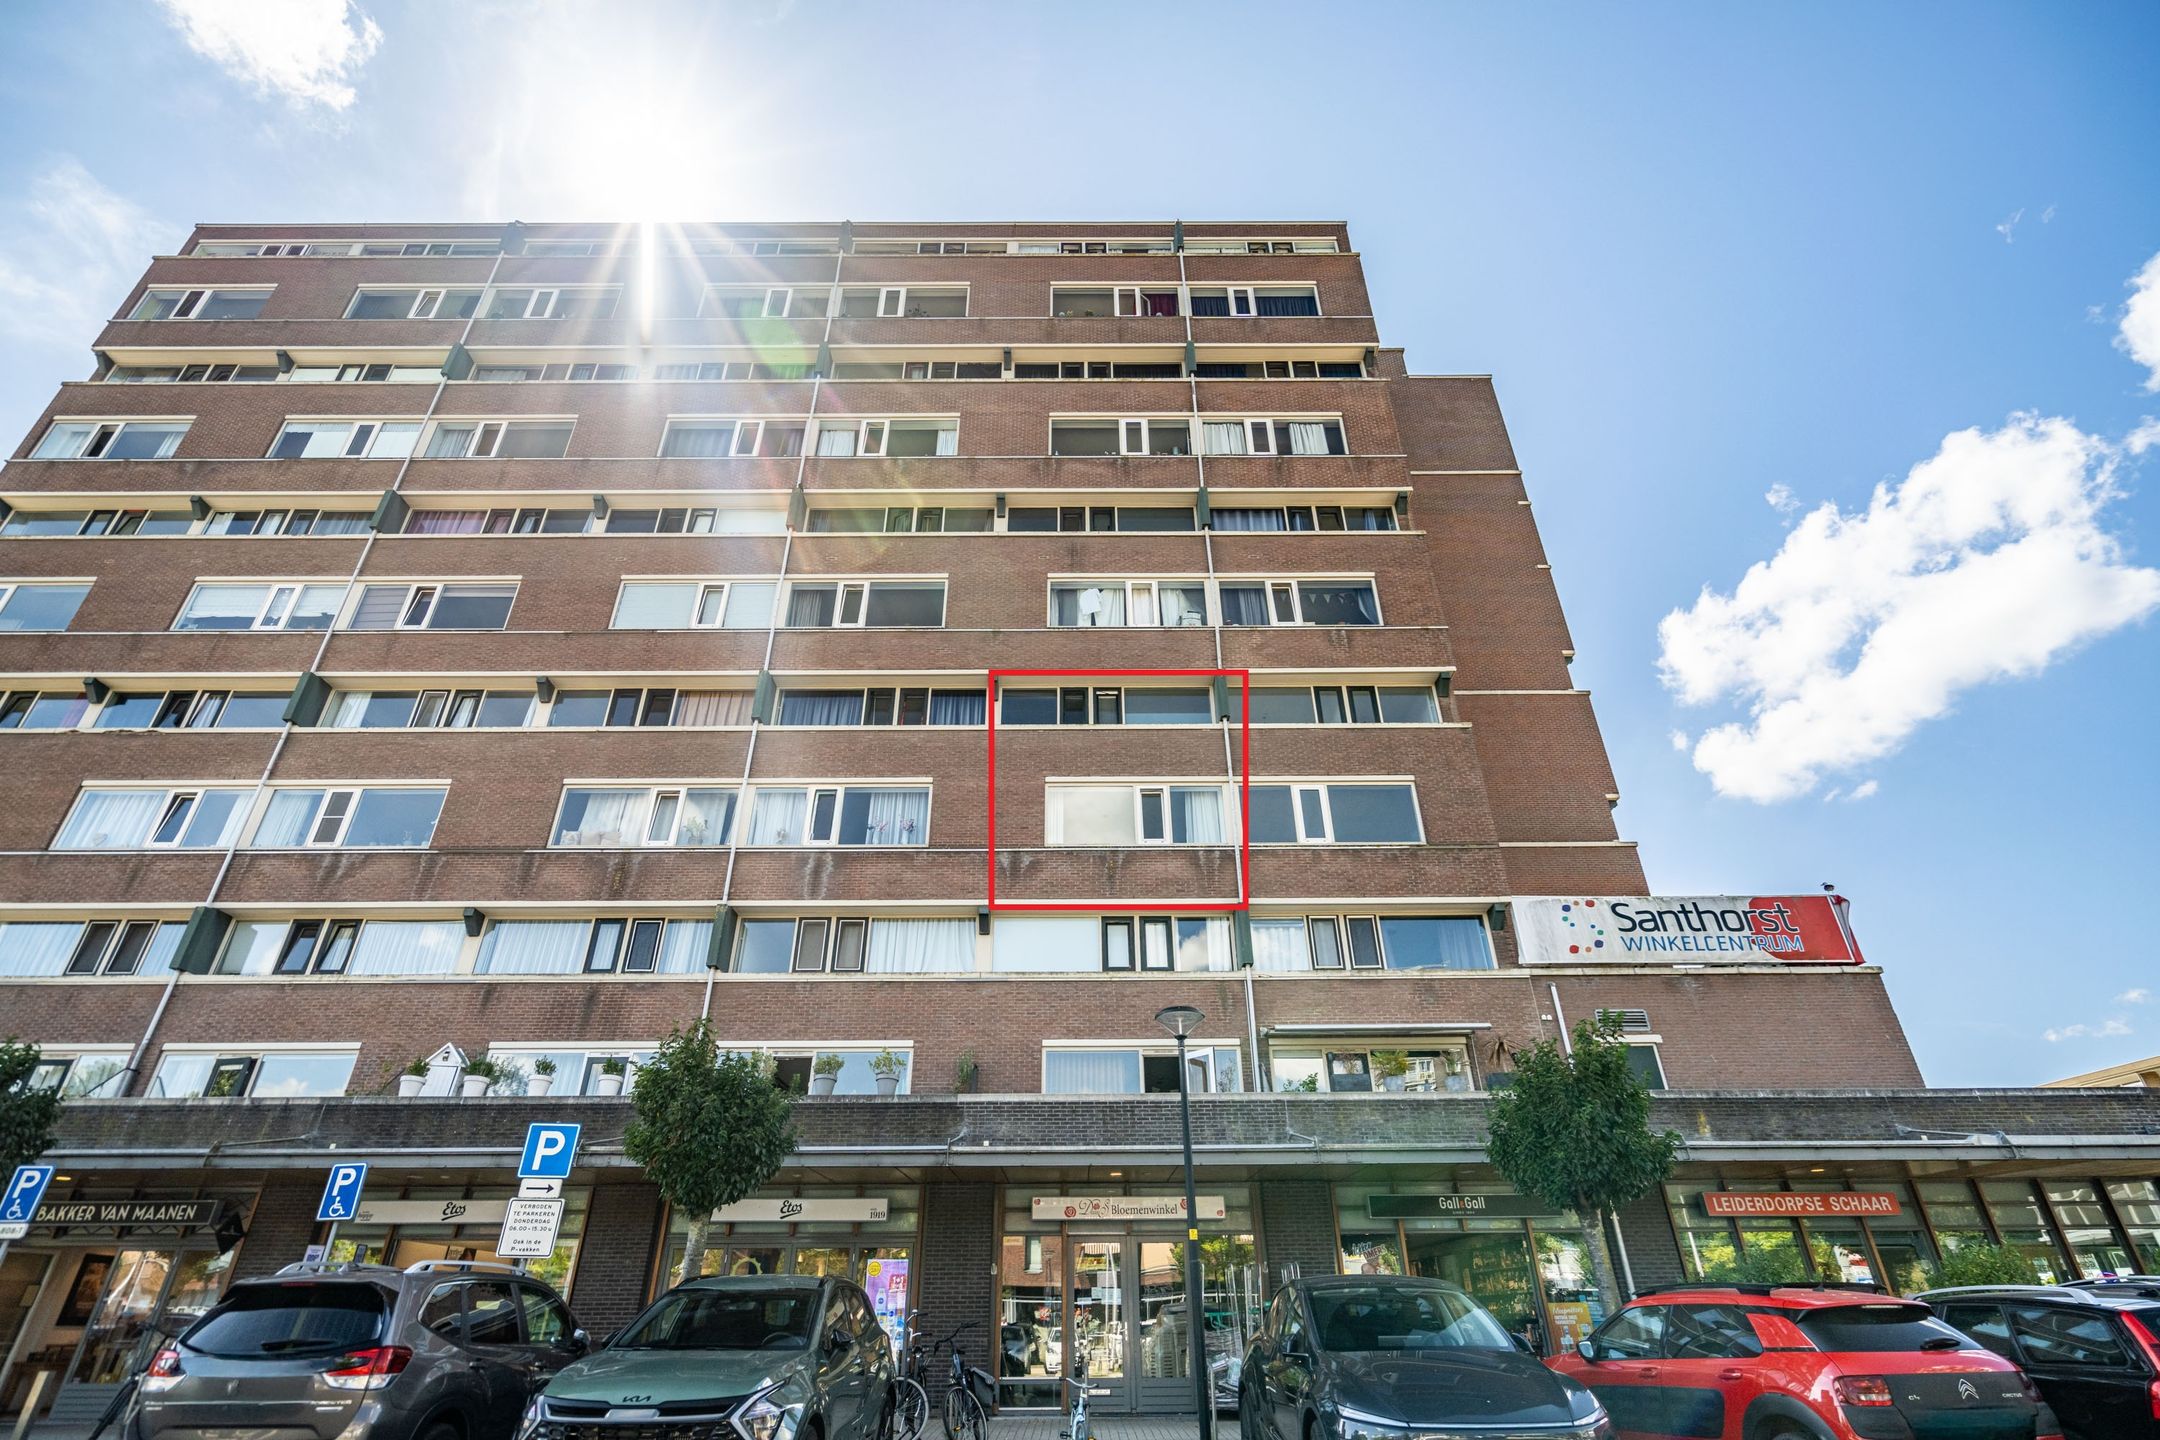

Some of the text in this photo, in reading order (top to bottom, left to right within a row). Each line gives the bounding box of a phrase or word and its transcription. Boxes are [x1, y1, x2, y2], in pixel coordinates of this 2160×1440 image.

[1610, 902, 1800, 933] Santhorst
[1620, 935, 1804, 952] WINKELCENTRUM
[531, 1130, 566, 1171] P
[12, 1170, 41, 1199] P
[331, 1167, 357, 1197] P
[35, 1204, 197, 1222] BAKKER VAN MAANEN
[441, 1201, 466, 1221] Etos
[780, 1200, 803, 1219] Etos
[1111, 1204, 1178, 1215] Bloemenwinkel
[1712, 1196, 1893, 1212] LEIDERDORPSE SCHAAR
[869, 1211, 886, 1219] 1919
